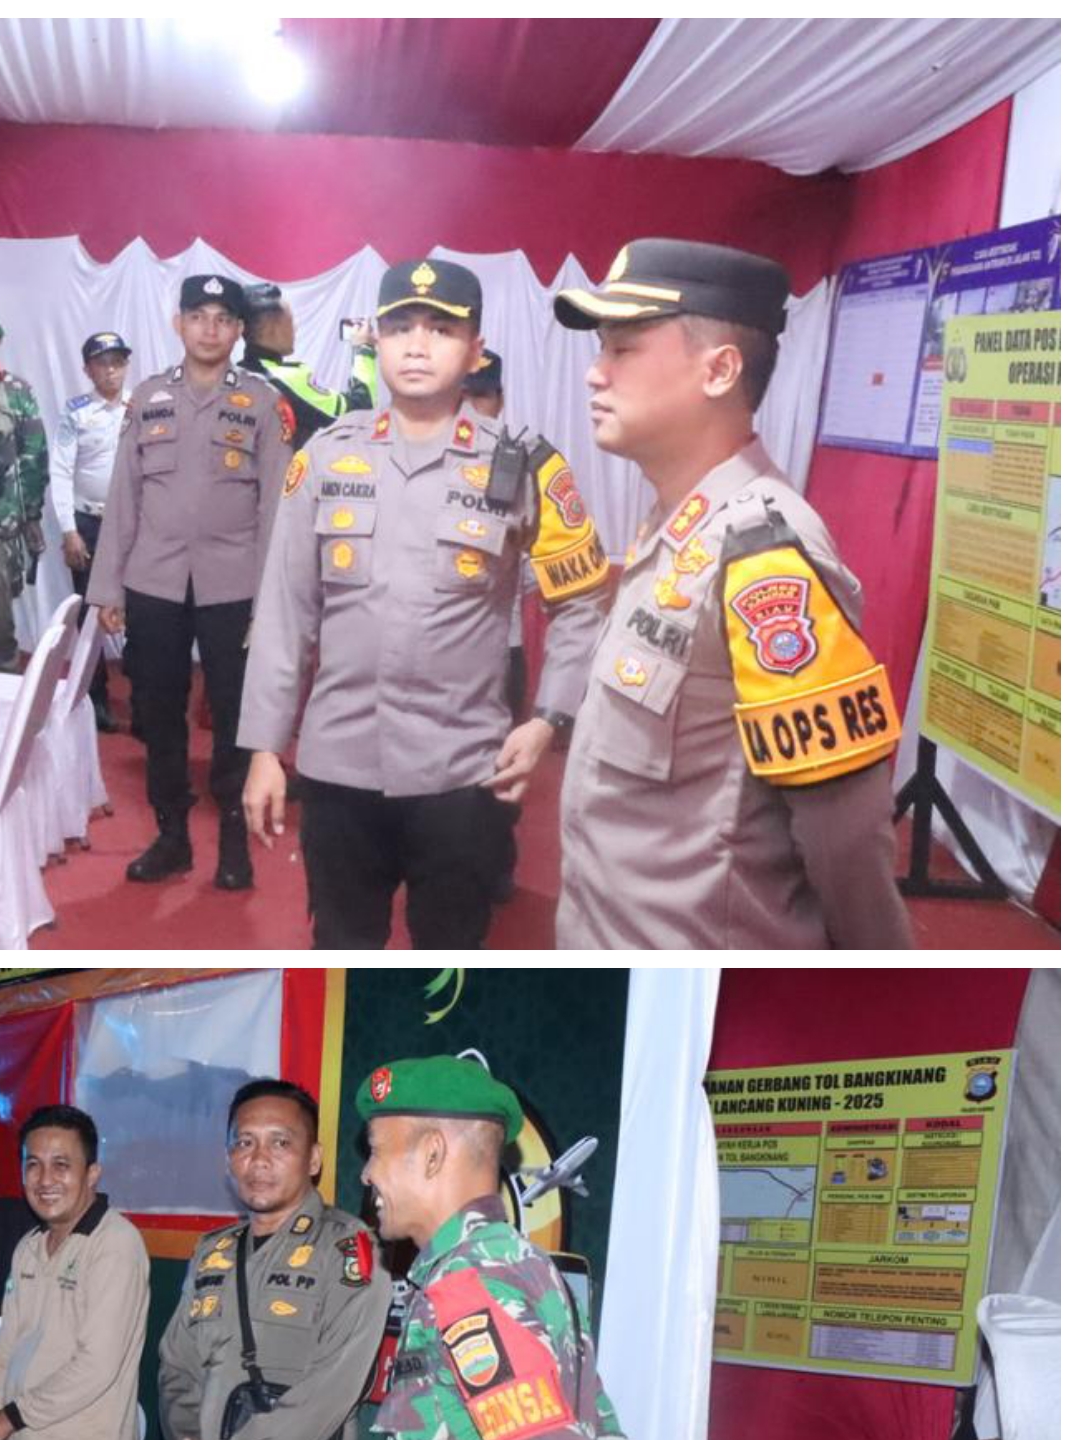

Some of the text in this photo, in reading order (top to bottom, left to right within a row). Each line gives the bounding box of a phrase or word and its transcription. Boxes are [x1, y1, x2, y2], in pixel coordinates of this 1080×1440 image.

[974, 326, 1056, 354] PANEL DATA POS
[1008, 361, 1056, 385] OPERASI
[219, 410, 256, 427] POLRI
[342, 482, 376, 499] CAKRA
[447, 490, 508, 517] POLRI
[544, 550, 592, 589] WAKA
[626, 606, 690, 659] POLRI
[772, 704, 837, 761] OPS
[838, 684, 888, 742] RES
[746, 1073, 811, 1093] GERBANG
[815, 1072, 841, 1090] TOL
[843, 1066, 947, 1089] BANGKINANG
[713, 1098, 776, 1115] LANCANG
[777, 1095, 832, 1113] KUNING
[843, 1092, 885, 1110] 2025
[868, 1254, 909, 1265] JARKOM
[267, 1273, 316, 1290] POL PP
[823, 1309, 948, 1327] NOMOR TELEPON PENTING
